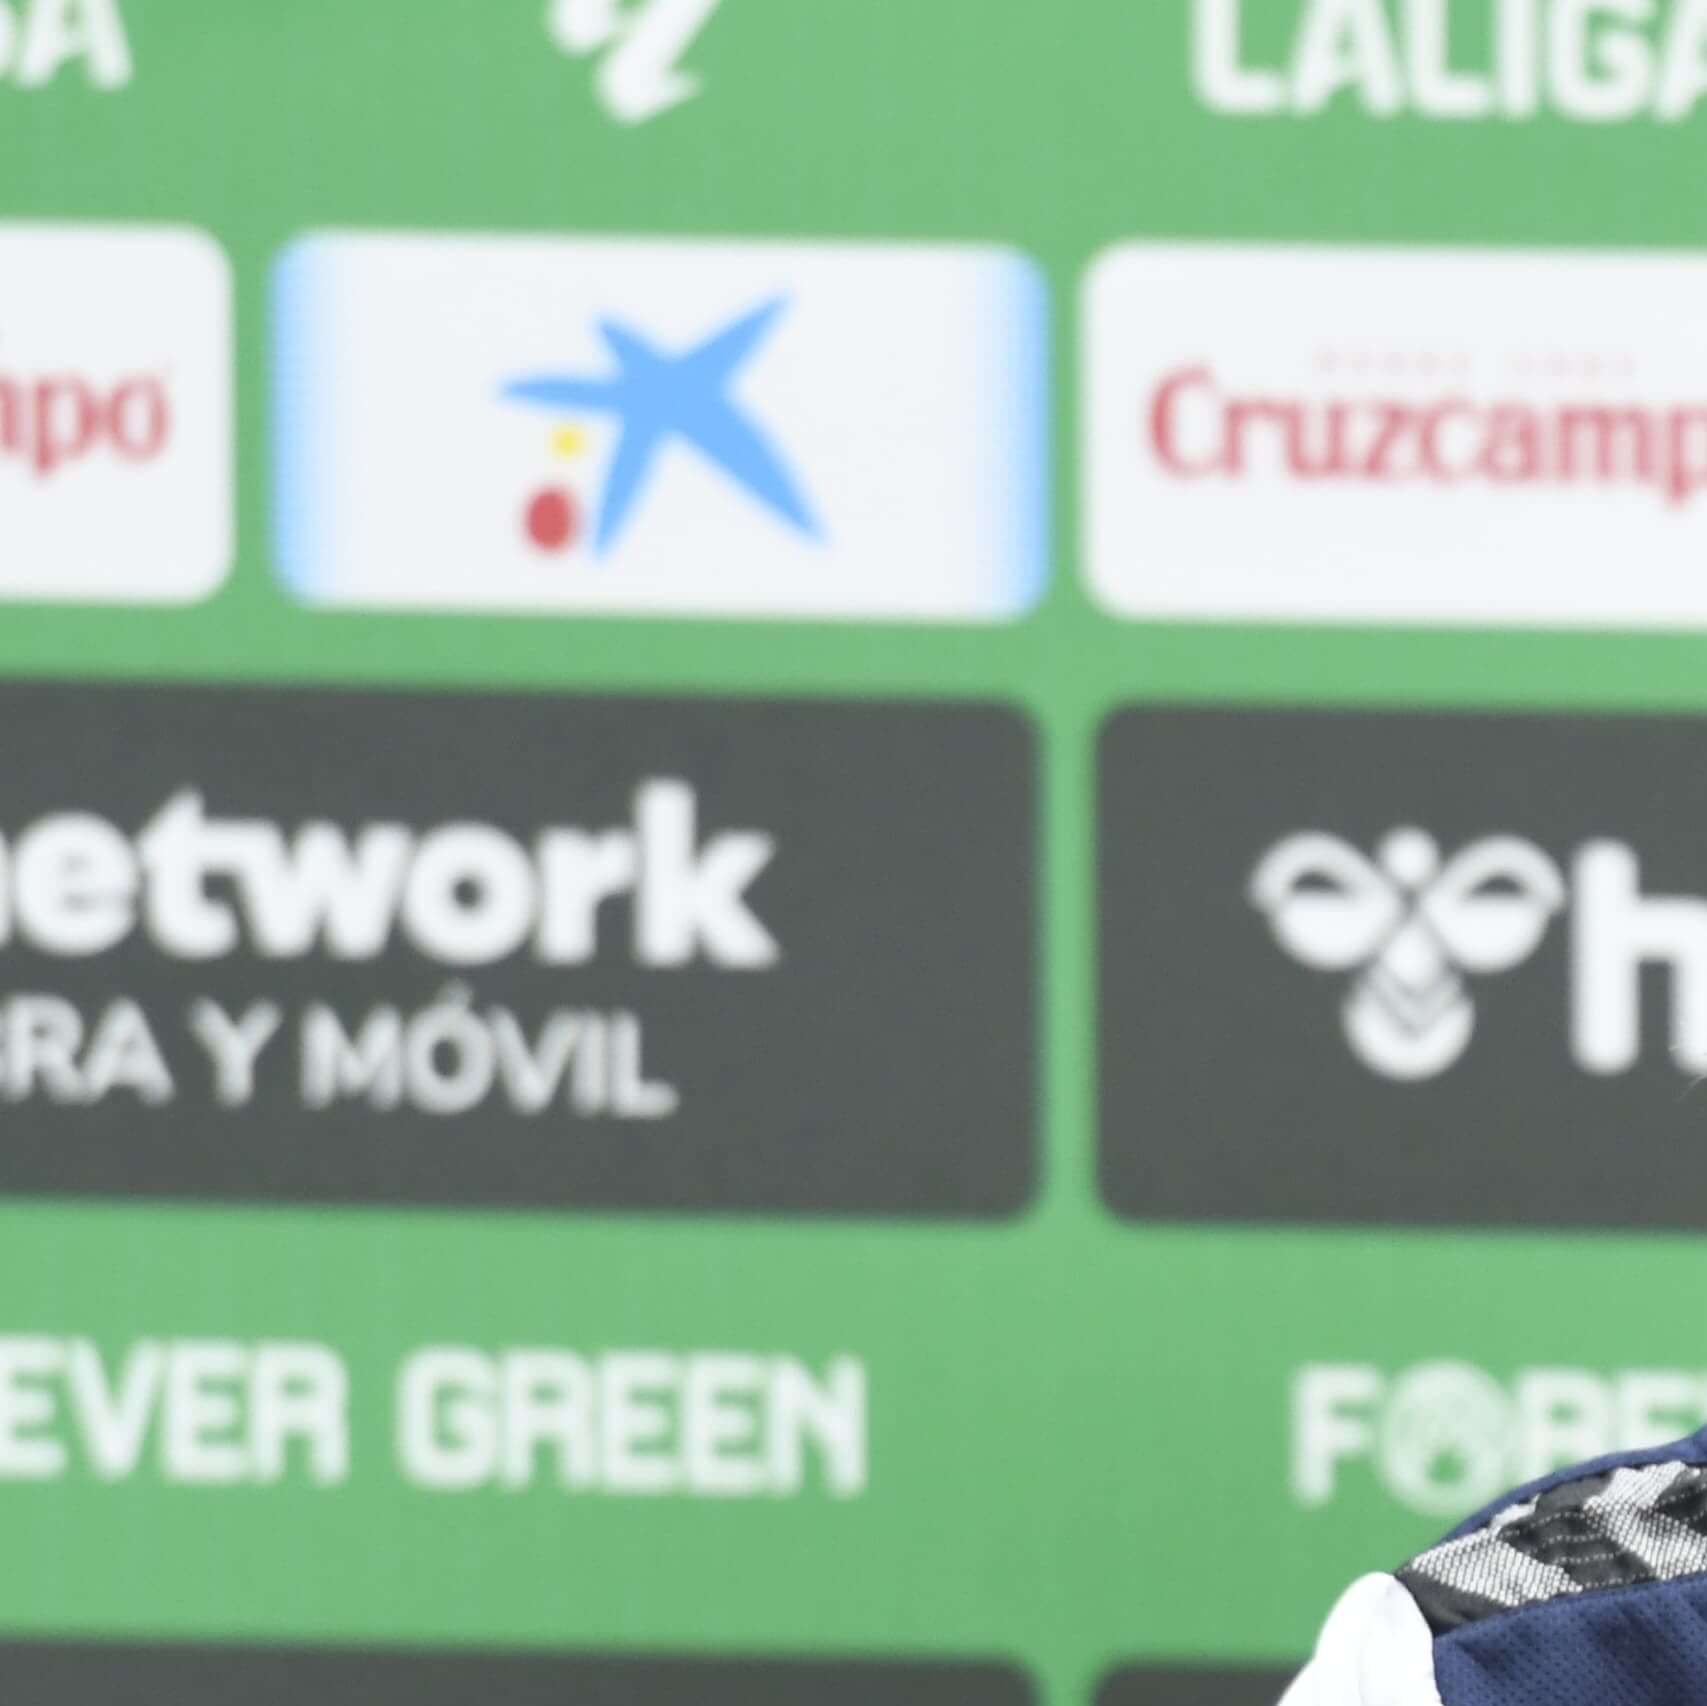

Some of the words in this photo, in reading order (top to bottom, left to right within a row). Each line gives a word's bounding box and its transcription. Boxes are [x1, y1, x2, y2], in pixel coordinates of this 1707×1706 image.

[0, 779, 778, 968] etwork
[0, 994, 174, 1102] RA
[194, 1001, 279, 1105] Y
[300, 980, 677, 1118] MÓVIL
[395, 1344, 867, 1497] GREEN
